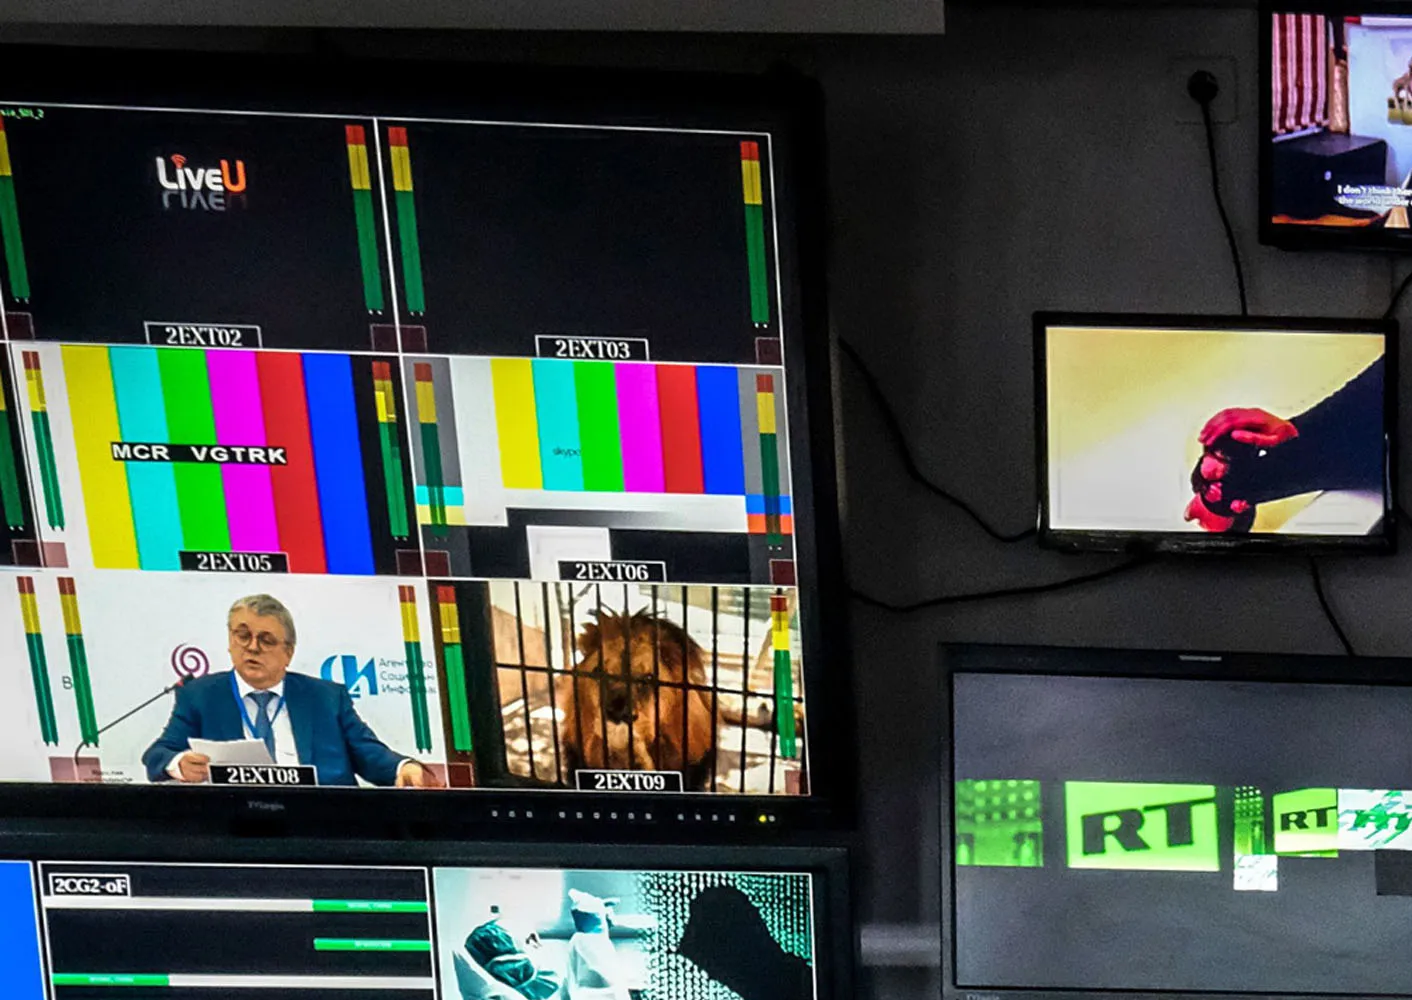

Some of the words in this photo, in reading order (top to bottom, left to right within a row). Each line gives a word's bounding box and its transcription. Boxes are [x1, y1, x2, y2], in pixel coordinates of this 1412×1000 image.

[156, 154, 246, 193] LiveU
[165, 326, 243, 347] 2EXT02
[555, 338, 631, 359] 2EXT03
[112, 443, 171, 460] MCR
[192, 446, 287, 464] VGTRK
[197, 553, 272, 572] 2EXT05
[575, 563, 649, 581] 2EXT06
[228, 766, 300, 785] 2EXT08
[594, 773, 665, 791] 2EXT09
[1081, 797, 1214, 855] RT
[1280, 805, 1337, 831] RT
[54, 877, 127, 895] 2CG2-oF
